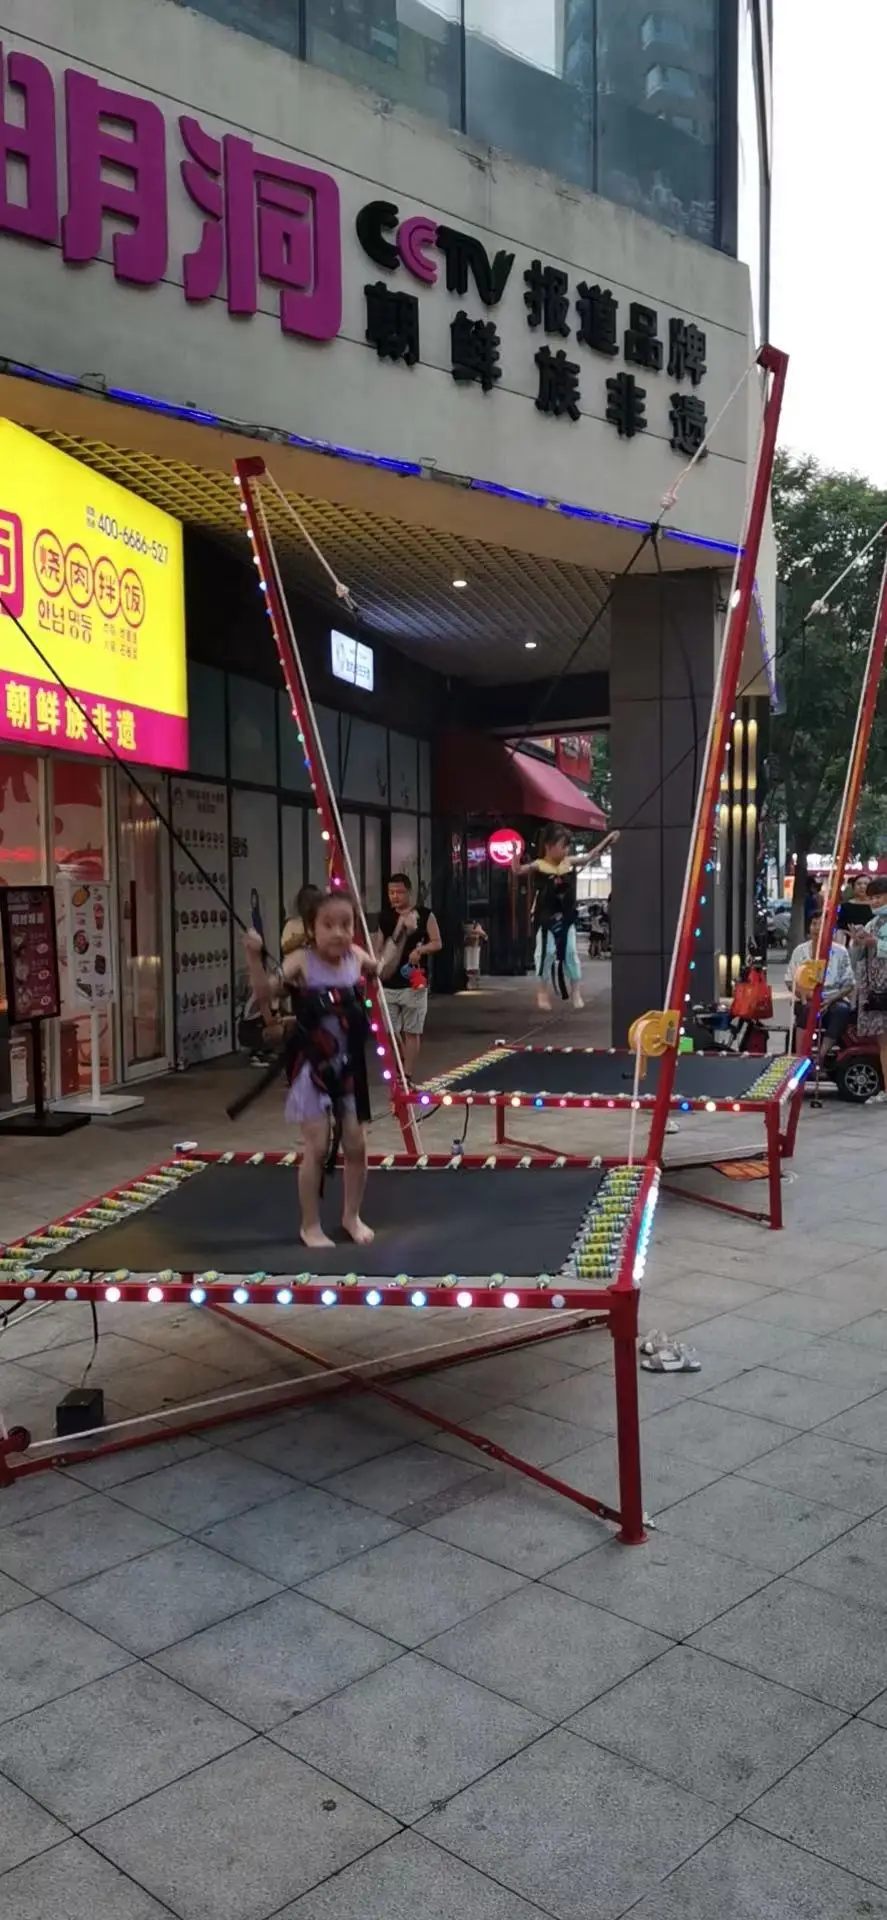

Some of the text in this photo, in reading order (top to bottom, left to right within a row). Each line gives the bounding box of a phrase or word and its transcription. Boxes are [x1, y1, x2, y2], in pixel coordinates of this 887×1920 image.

[356, 200, 516, 305] CCTV
[523, 258, 707, 386] 报道品牌
[364, 280, 709, 459] 朝鲜族非遗
[38, 544, 141, 614] 烧肉拌饭
[98, 513, 168, 564] 400-6686-527
[5, 680, 137, 750] 朝鲜族非遗
